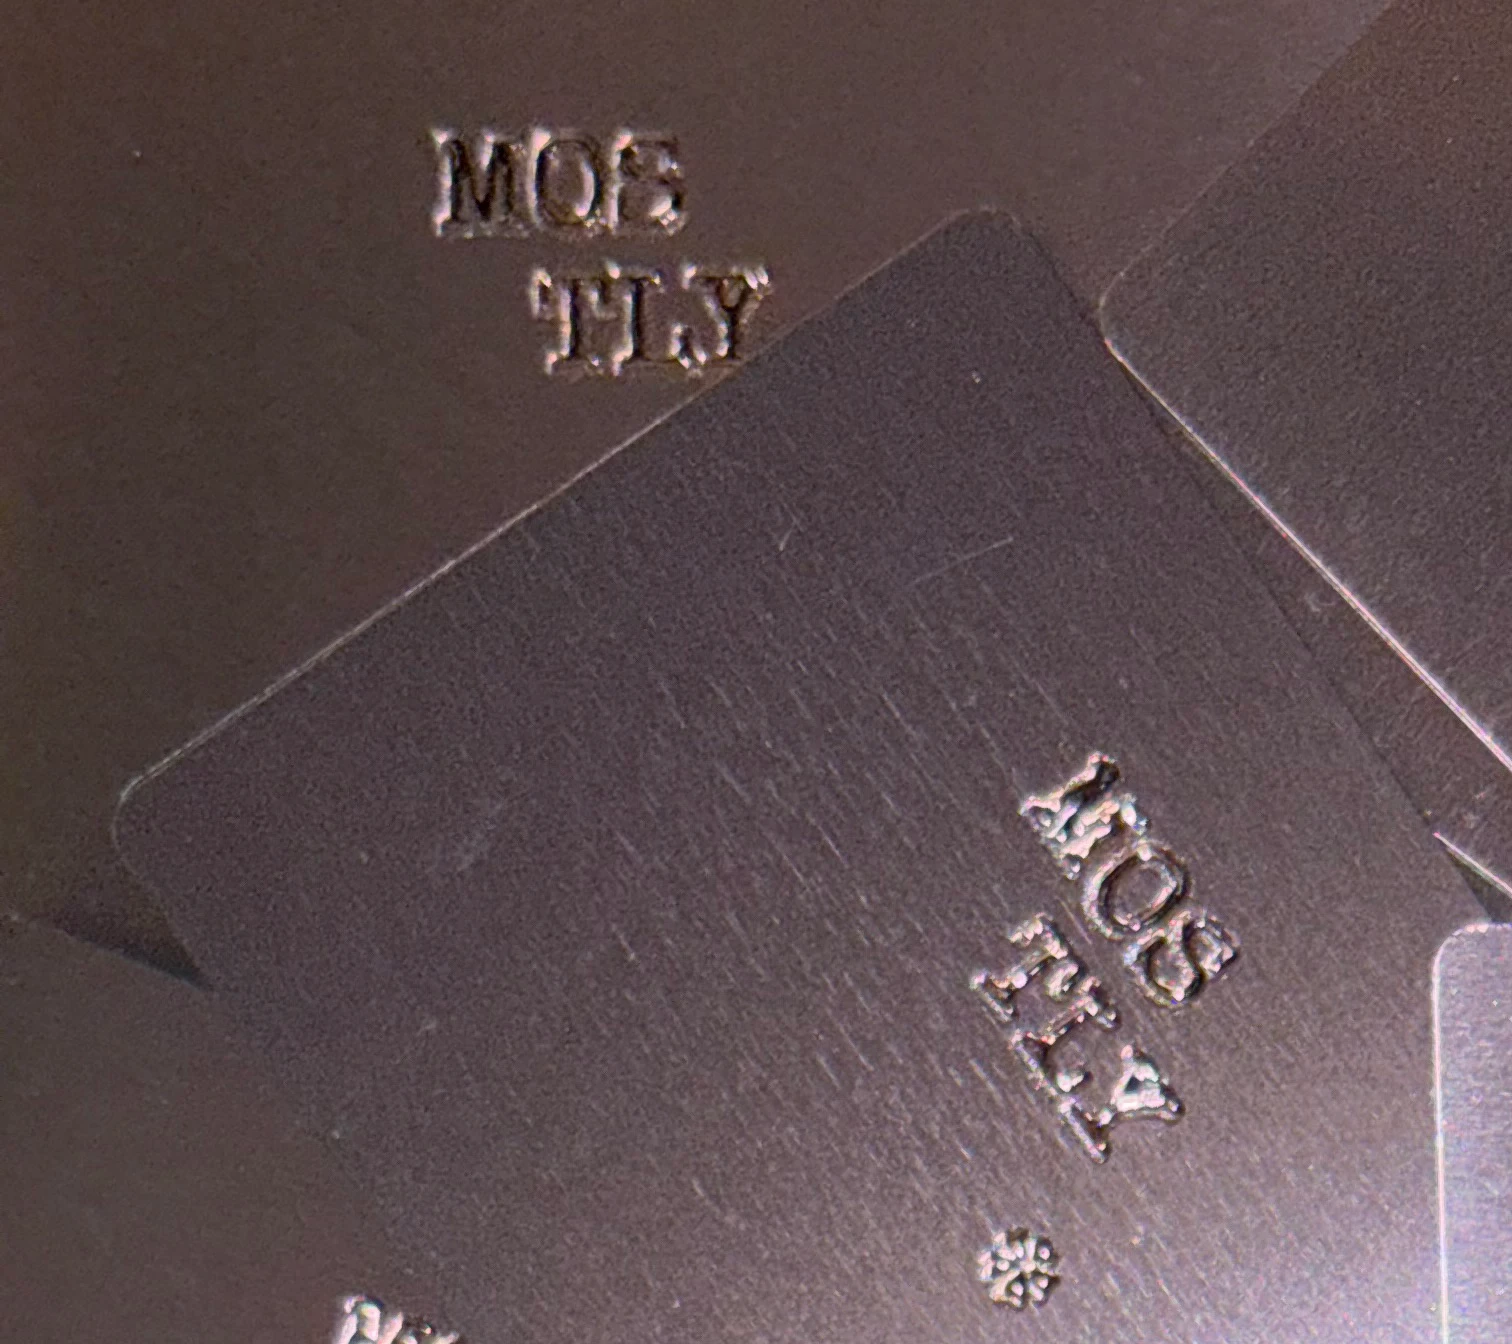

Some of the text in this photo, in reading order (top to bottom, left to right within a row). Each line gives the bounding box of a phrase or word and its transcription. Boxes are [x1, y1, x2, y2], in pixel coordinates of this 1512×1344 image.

[530, 262, 771, 376] TLY
[1018, 750, 1240, 1008] MOS
[969, 912, 1186, 1164] TLY
